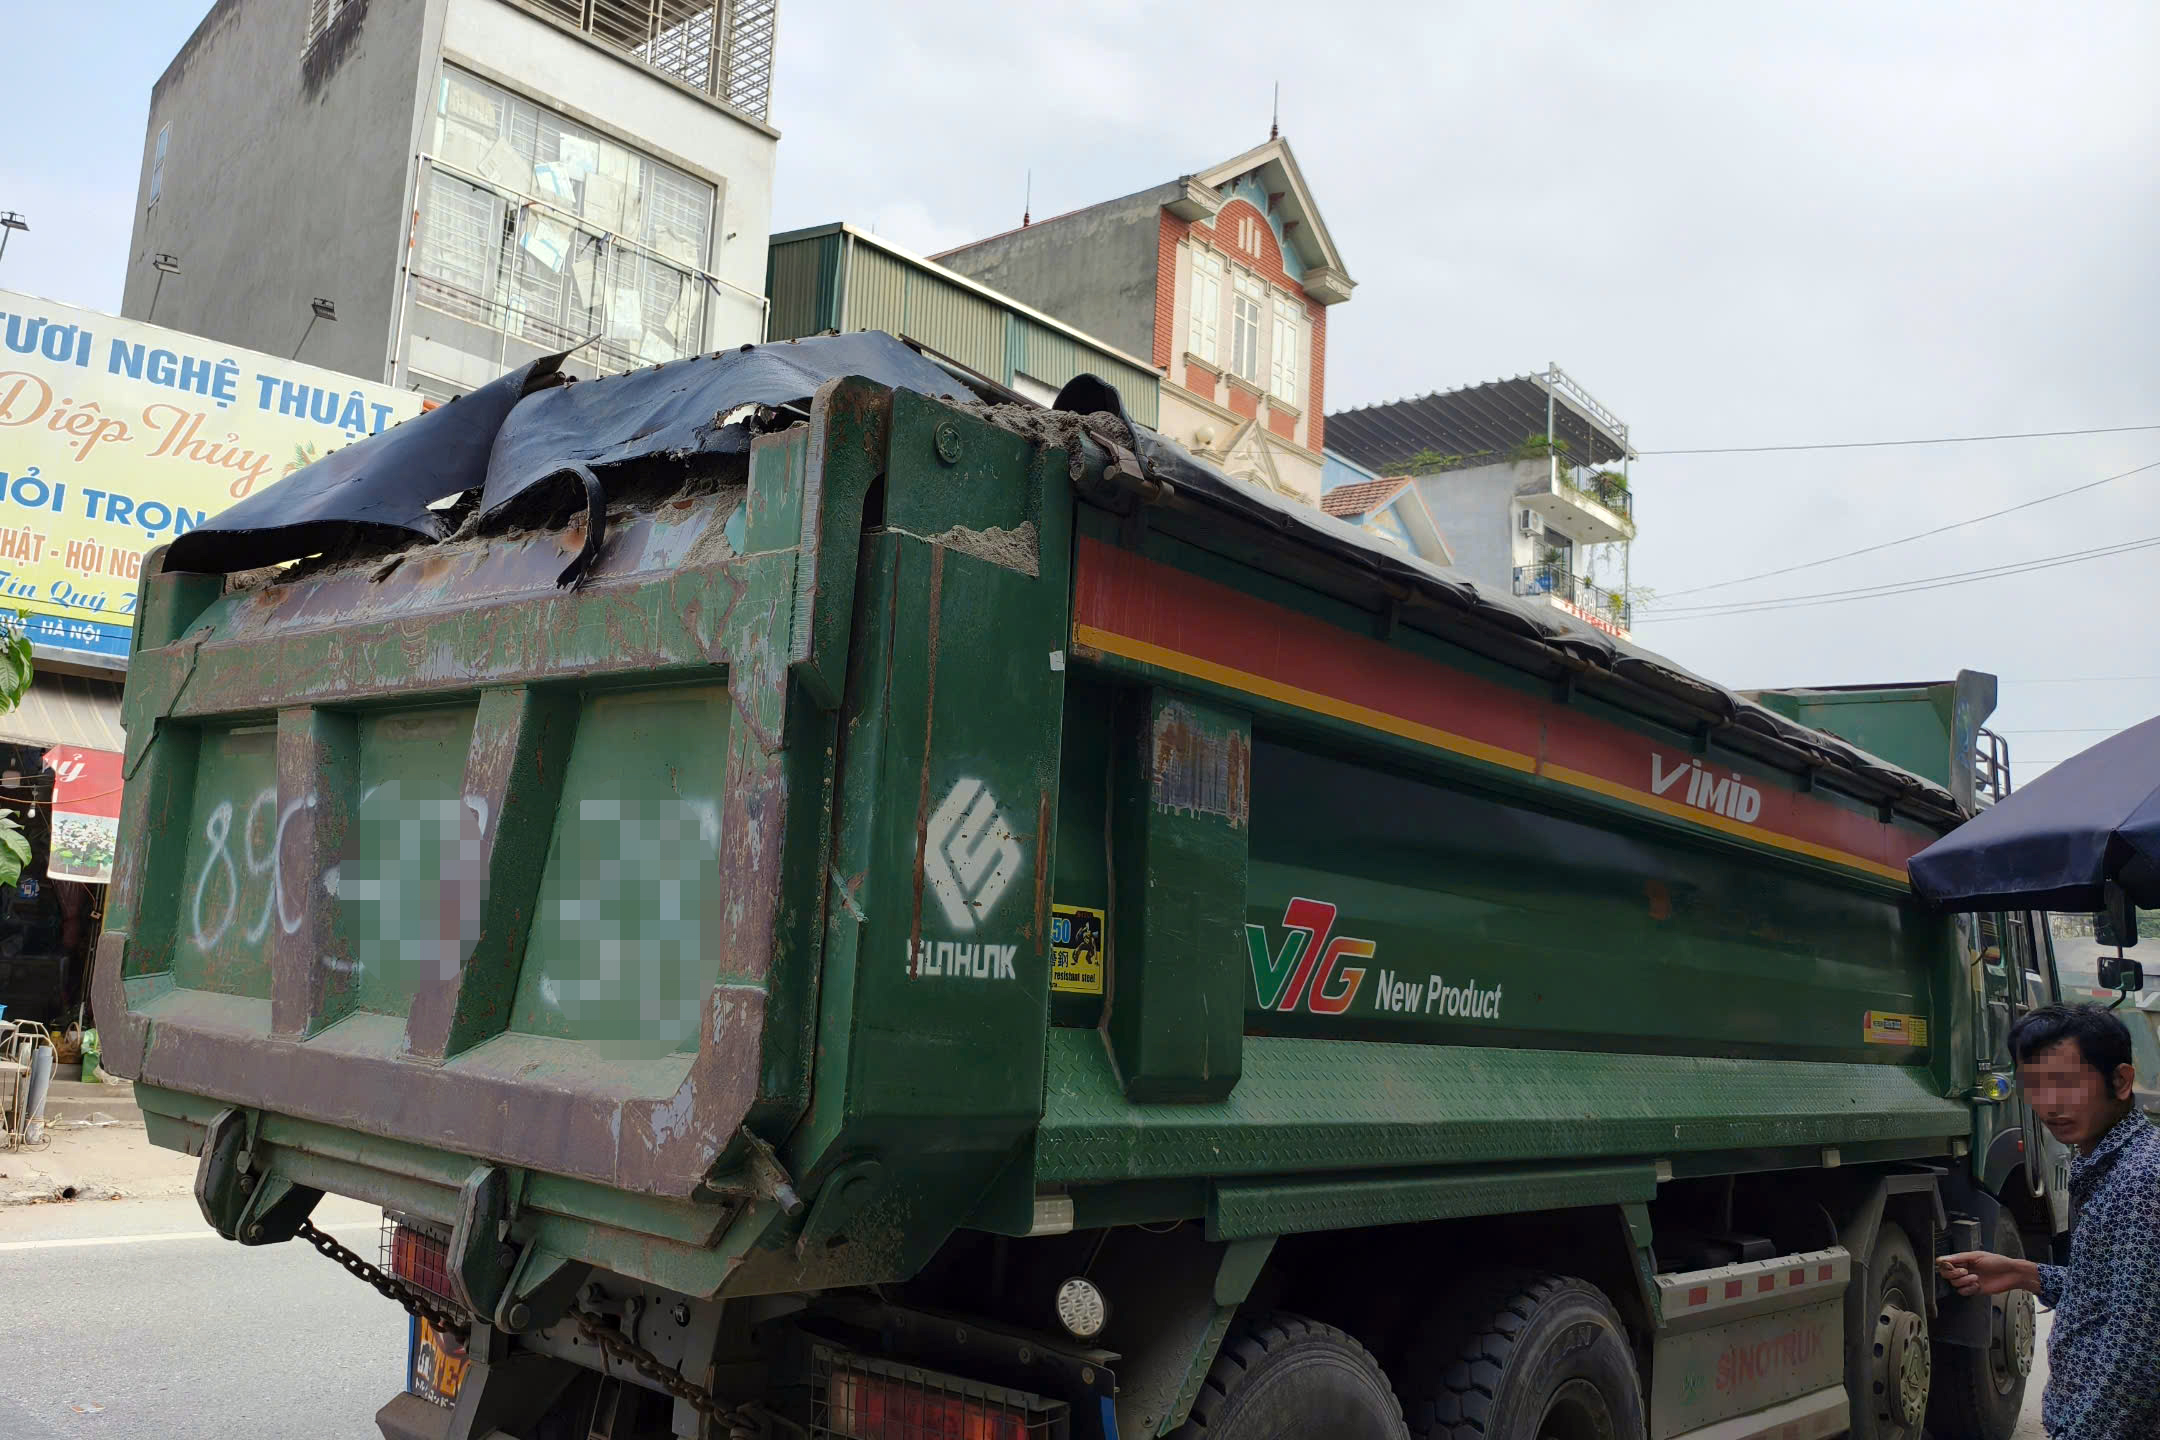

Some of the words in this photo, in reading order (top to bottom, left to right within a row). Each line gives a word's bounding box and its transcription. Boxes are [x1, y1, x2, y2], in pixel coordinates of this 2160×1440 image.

[108, 338, 240, 408] NGHỆ
[255, 374, 394, 438] THUẬT
[142, 403, 272, 498] Thủy
[0, 526, 46, 567] HẬT
[65, 537, 105, 578] HỘI
[49, 580, 106, 613] Quý
[41, 619, 65, 637] HÀ
[70, 623, 101, 645] NỘI
[1374, 969, 1423, 1013] New
[1425, 974, 1502, 1019] Product
